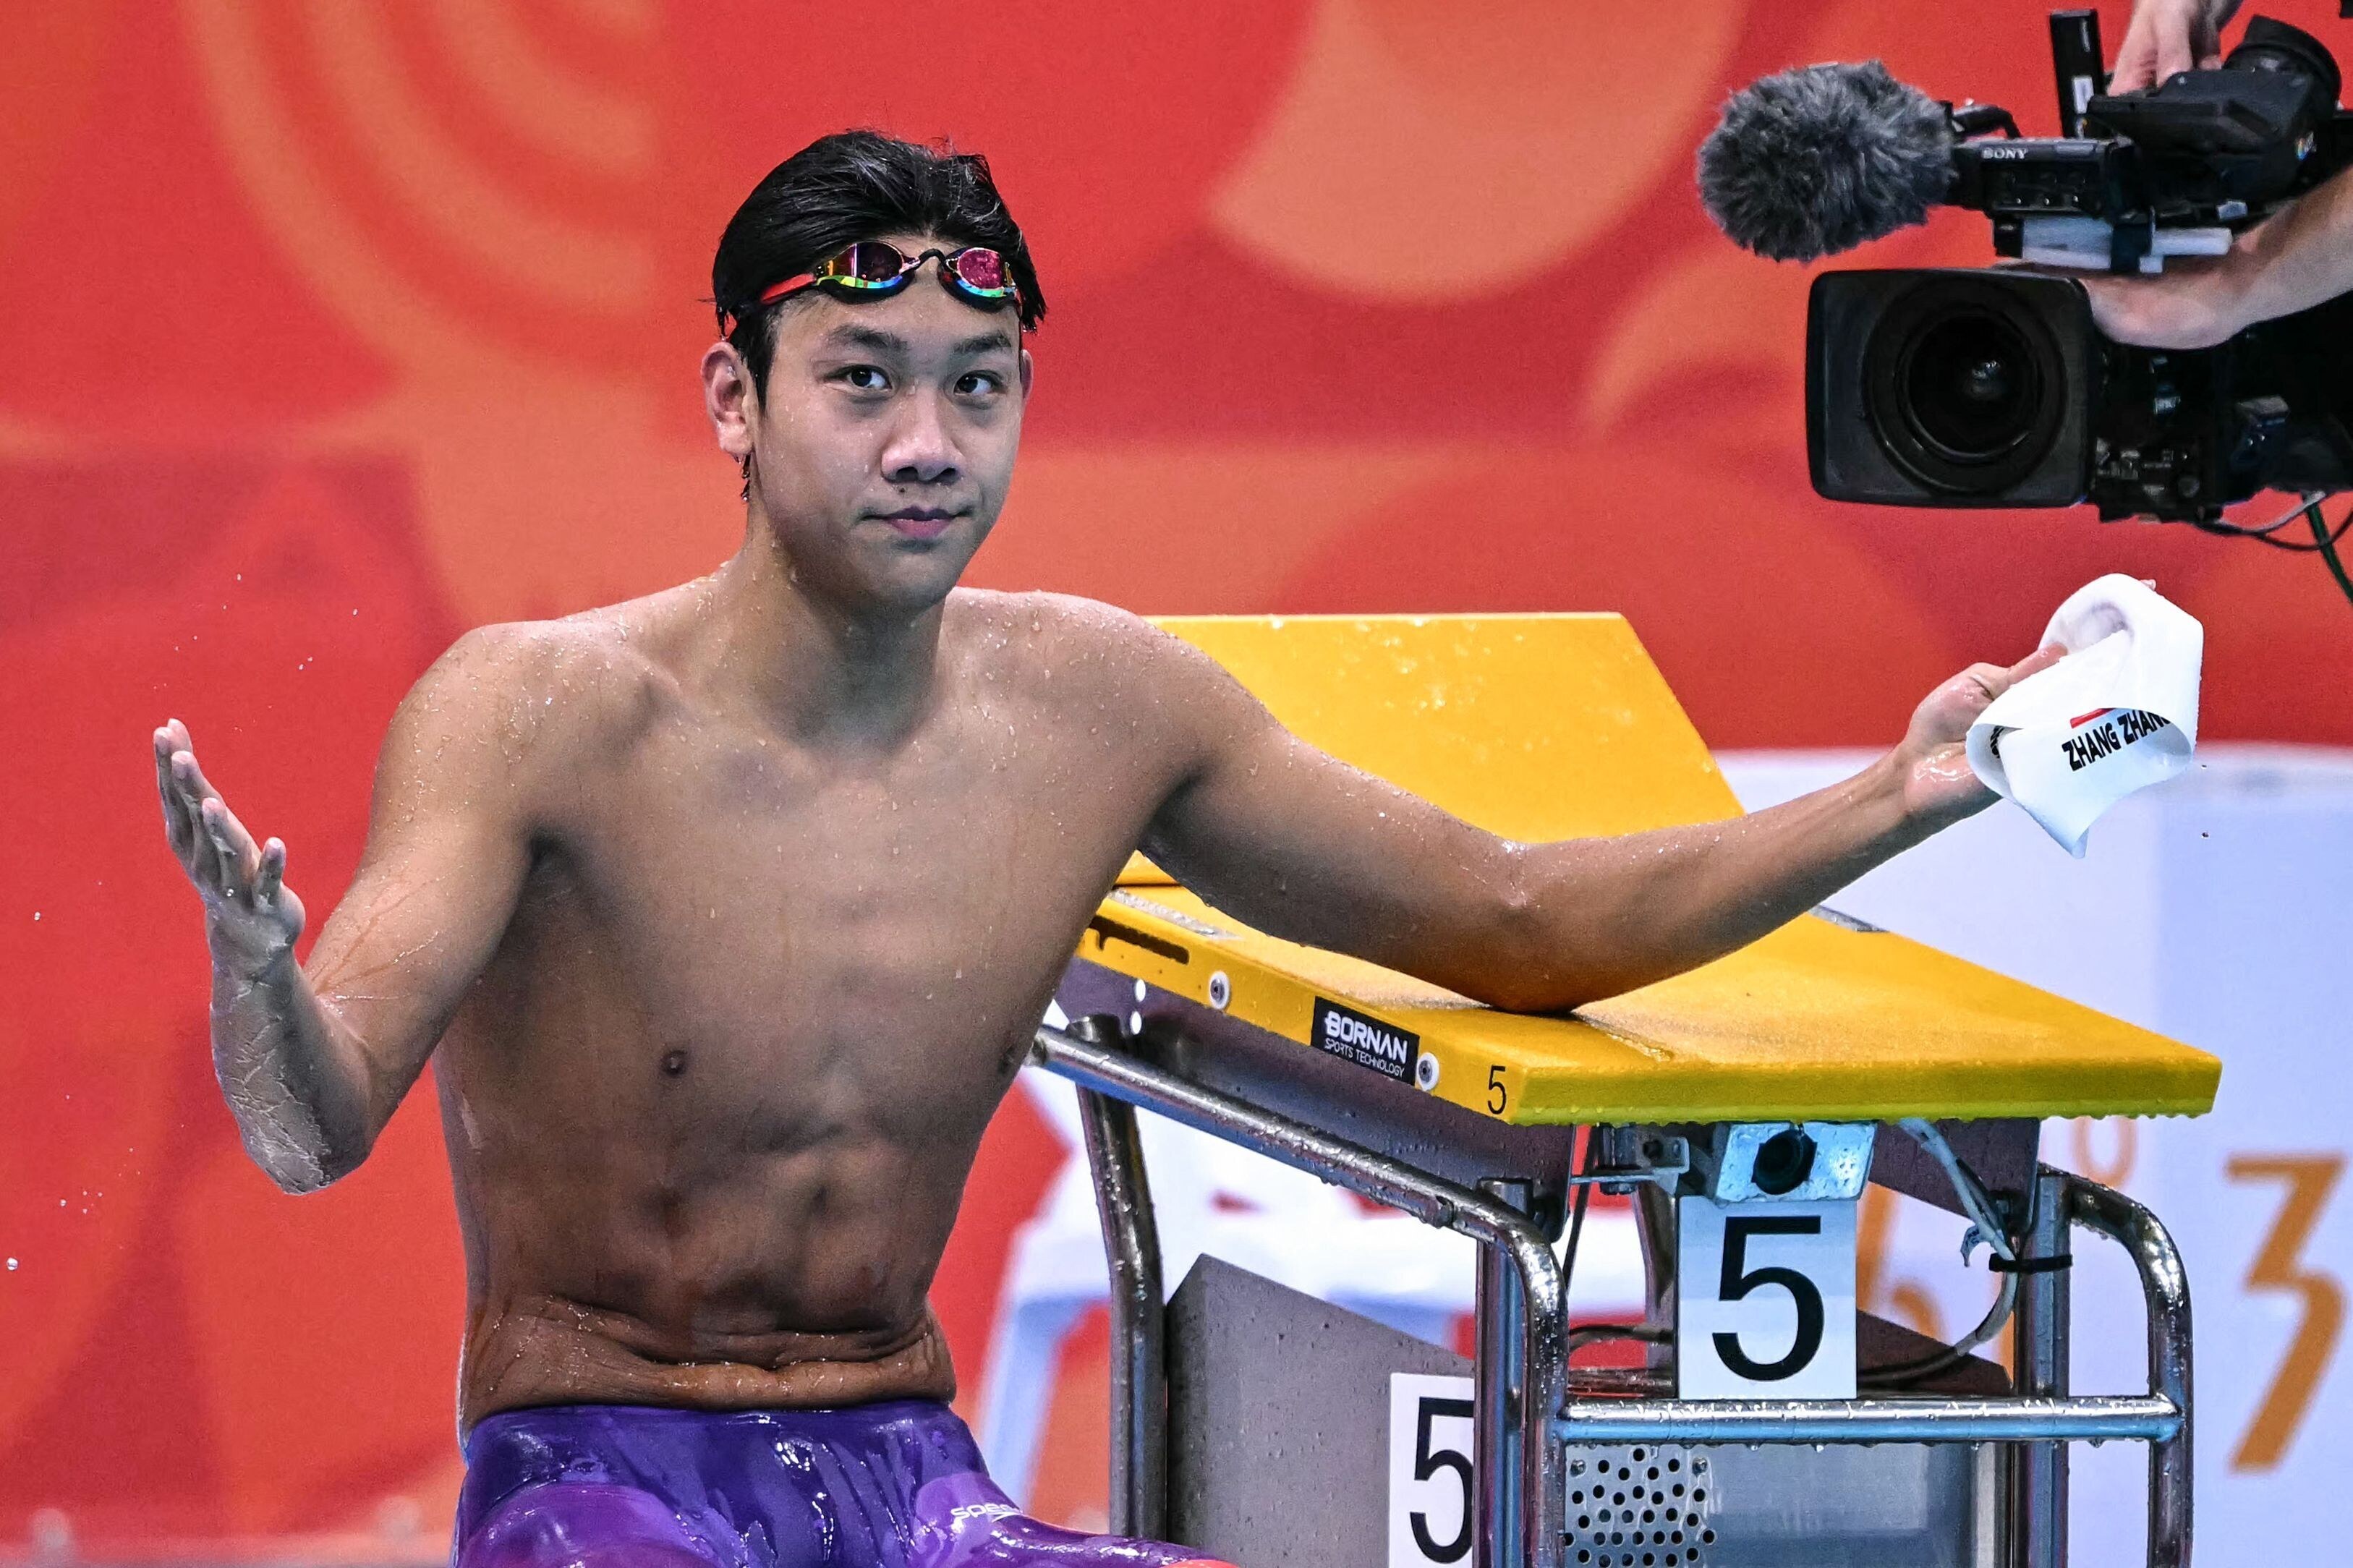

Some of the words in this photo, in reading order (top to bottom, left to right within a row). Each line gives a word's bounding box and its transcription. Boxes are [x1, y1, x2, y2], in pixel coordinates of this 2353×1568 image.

[1983, 147, 2028, 159] SONY
[2061, 723, 2122, 771] ZHANG
[2116, 710, 2170, 745] ZHAN
[1324, 1010, 1408, 1064] BORNAN
[1324, 1037, 1353, 1058] SPORTS
[1356, 1049, 1405, 1078] TECHNOLOGY
[1488, 1065, 1507, 1115] 5
[1712, 1216, 1824, 1381] 5
[1410, 1397, 1474, 1564] 5
